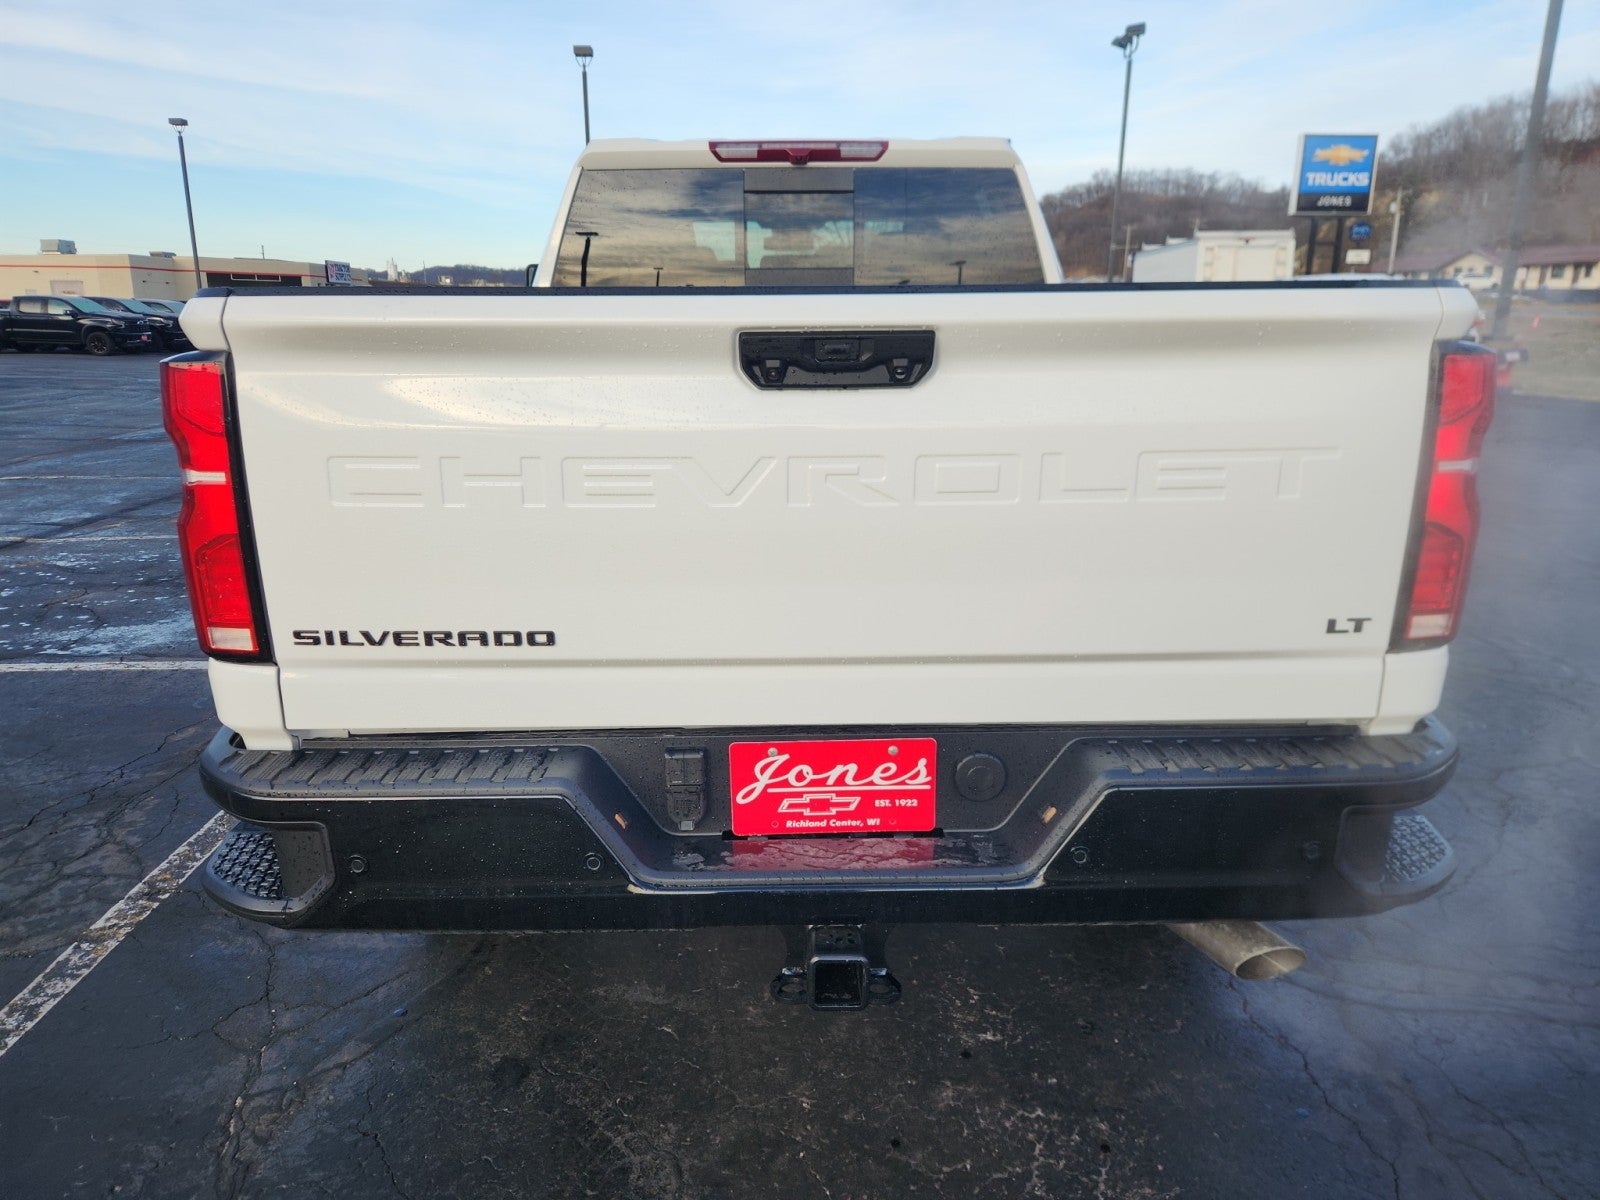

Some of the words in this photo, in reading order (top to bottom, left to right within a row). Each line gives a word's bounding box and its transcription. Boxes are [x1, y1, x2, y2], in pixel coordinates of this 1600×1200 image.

[1306, 171, 1370, 187] TRUCKS
[1317, 195, 1352, 207] JONES
[327, 446, 1341, 508] CHEVROLET
[1326, 617, 1372, 634] LT
[292, 629, 557, 647] SILVERADO
[735, 753, 932, 805] Jones
[874, 799, 892, 808] EST.
[895, 798, 919, 808] 1922
[786, 819, 828, 828] Richland
[829, 818, 864, 829] Center,
[866, 818, 881, 827] WI
